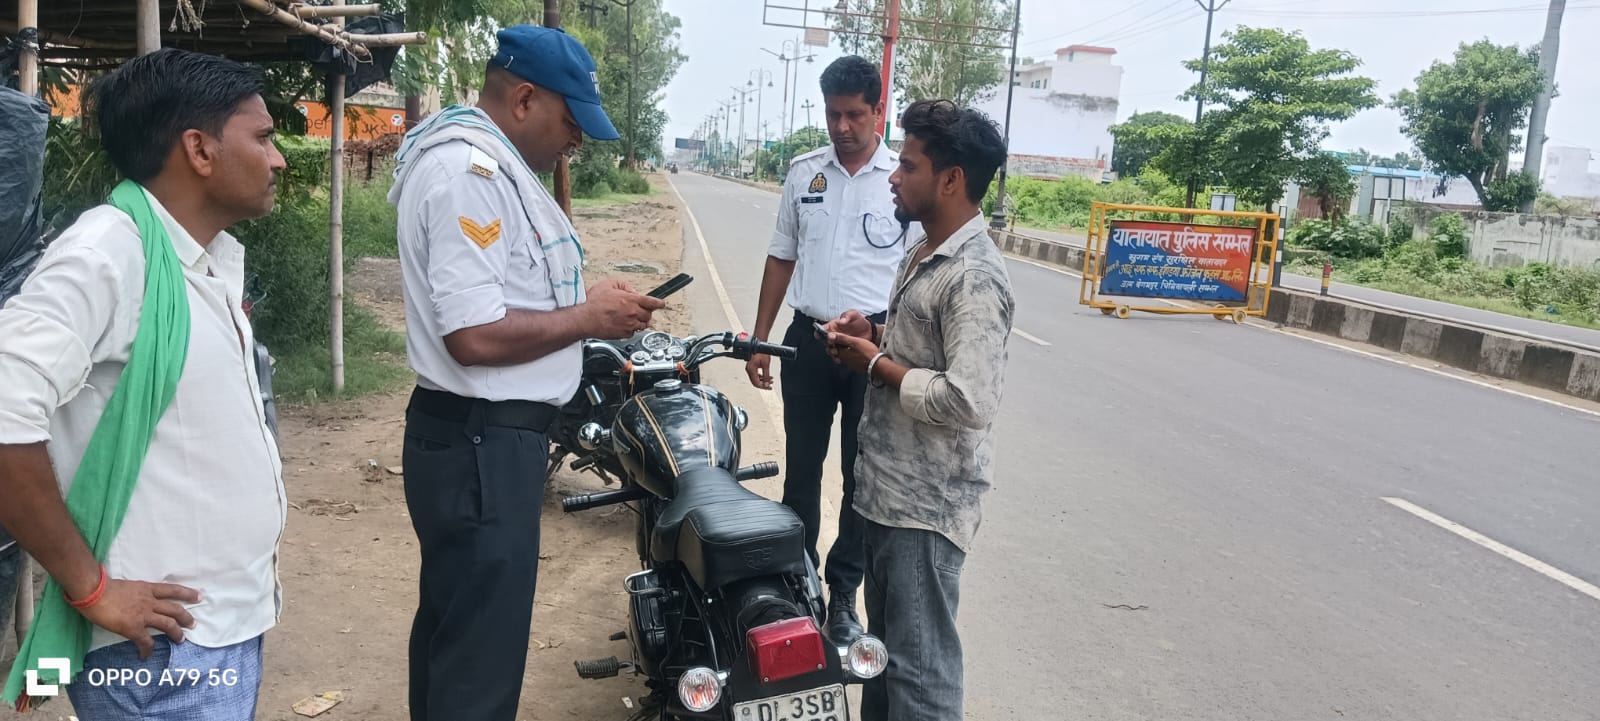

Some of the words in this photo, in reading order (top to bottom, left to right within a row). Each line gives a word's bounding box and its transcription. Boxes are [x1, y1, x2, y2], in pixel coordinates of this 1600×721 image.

[1112, 228, 1172, 250] यातायात
[1173, 226, 1212, 253] पुलिस
[1212, 233, 1252, 256] सम्भल
[1166, 253, 1196, 266] सुरक्षित
[790, 690, 835, 718] 3SB
